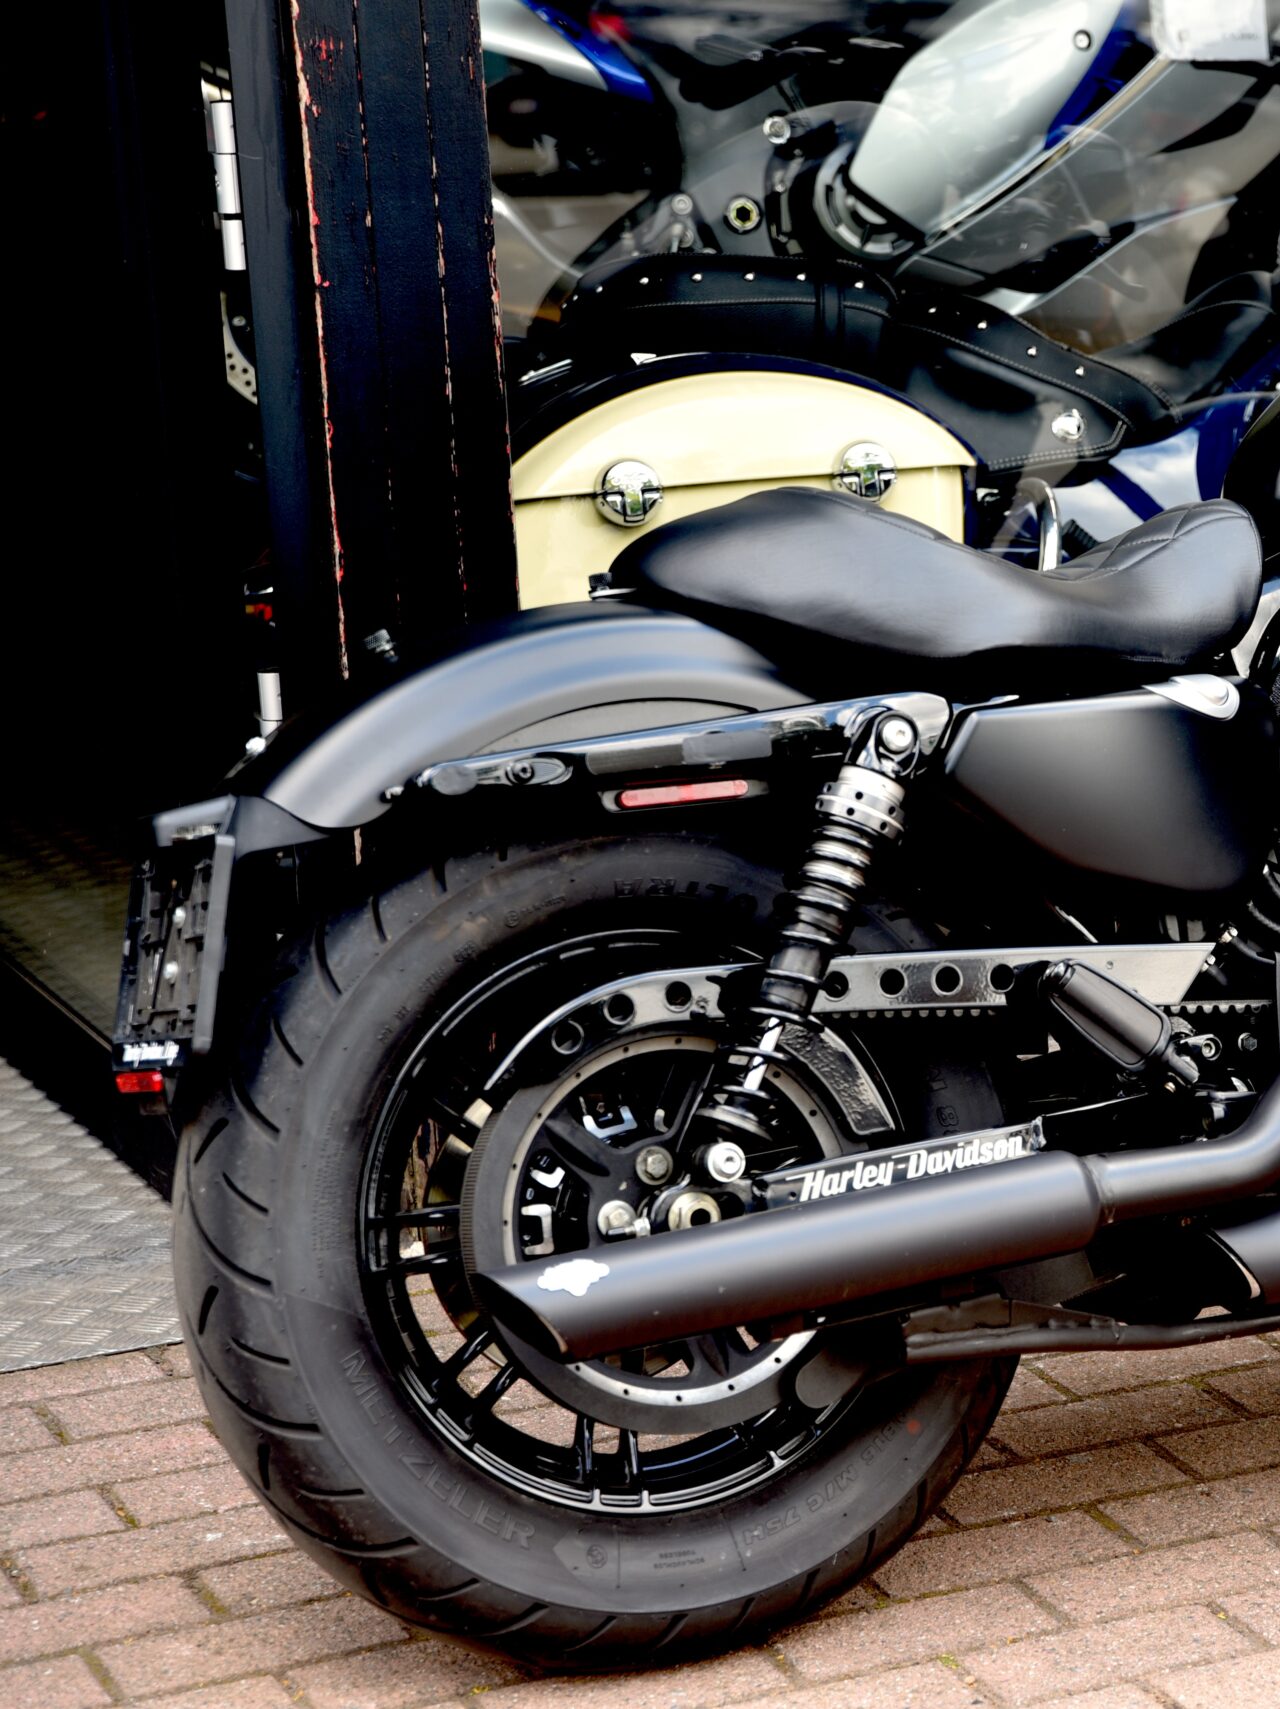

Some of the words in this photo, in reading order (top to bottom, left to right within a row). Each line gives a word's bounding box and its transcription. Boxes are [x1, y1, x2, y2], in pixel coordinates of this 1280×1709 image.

[785, 1134, 1026, 1202] Harley-Davidson
[340, 1350, 536, 1550] METZELER
[741, 1506, 800, 1547] 75H
